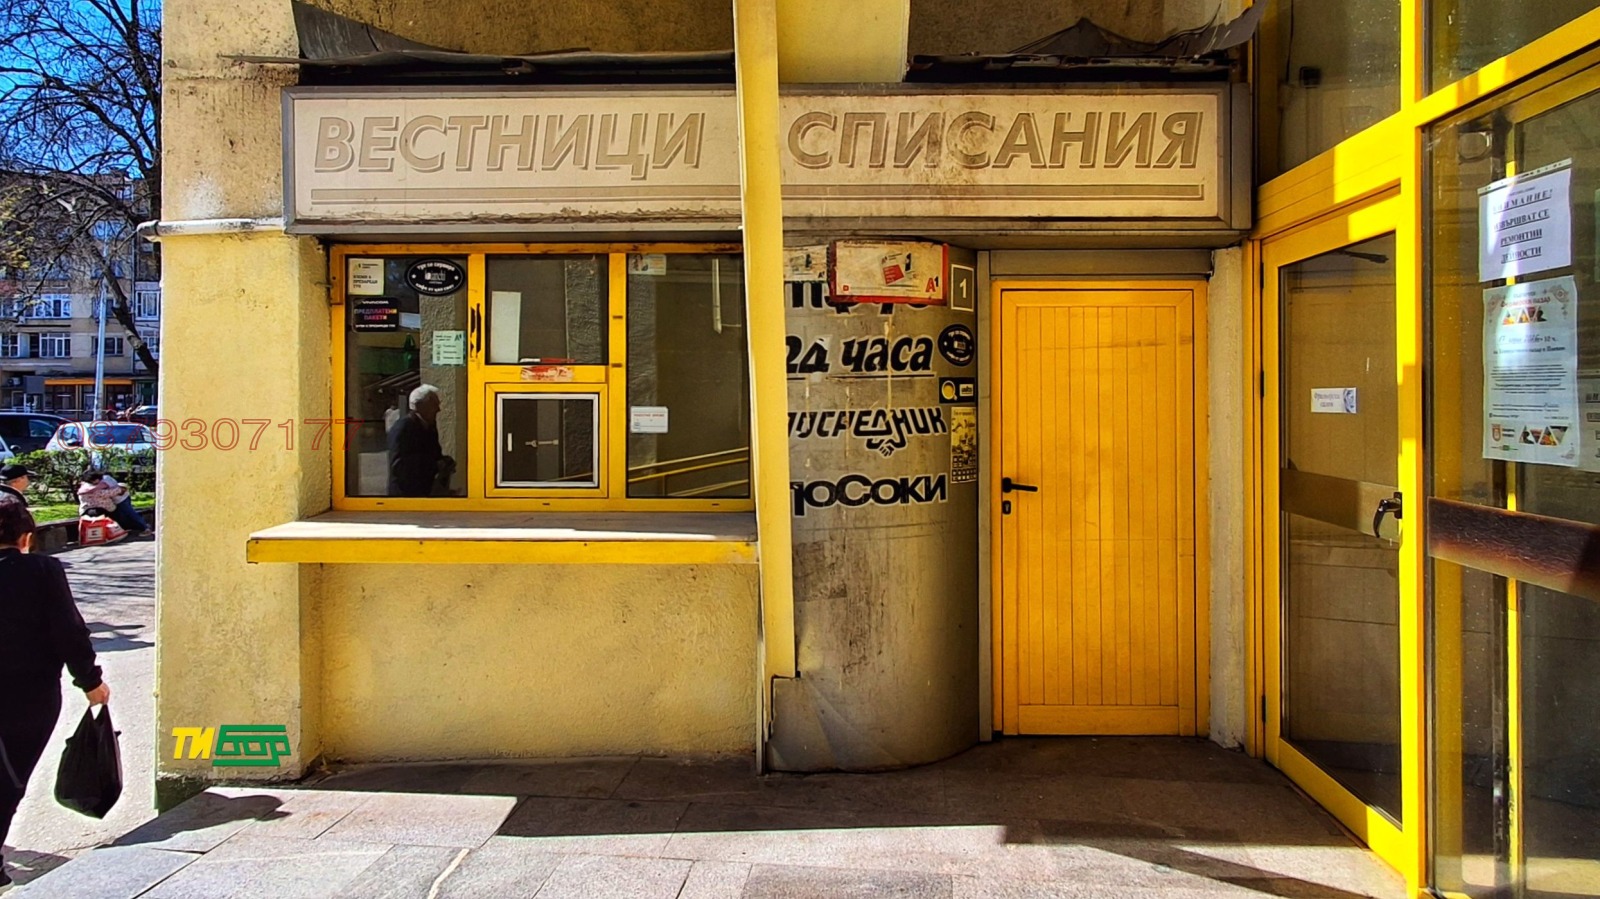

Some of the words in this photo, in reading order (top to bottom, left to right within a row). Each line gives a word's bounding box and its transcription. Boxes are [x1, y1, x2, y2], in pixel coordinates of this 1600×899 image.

[314, 113, 706, 180] ВЕСТНИЦИ
[787, 111, 1205, 169] СПИСАНИЯ
[1493, 189, 1553, 211] ИМАНИЕ!
[1494, 211, 1538, 230] ВЪРШВАТ
[925, 275, 939, 293] A1
[959, 278, 967, 299] 1
[785, 335, 830, 373] 24
[841, 337, 935, 373] часа
